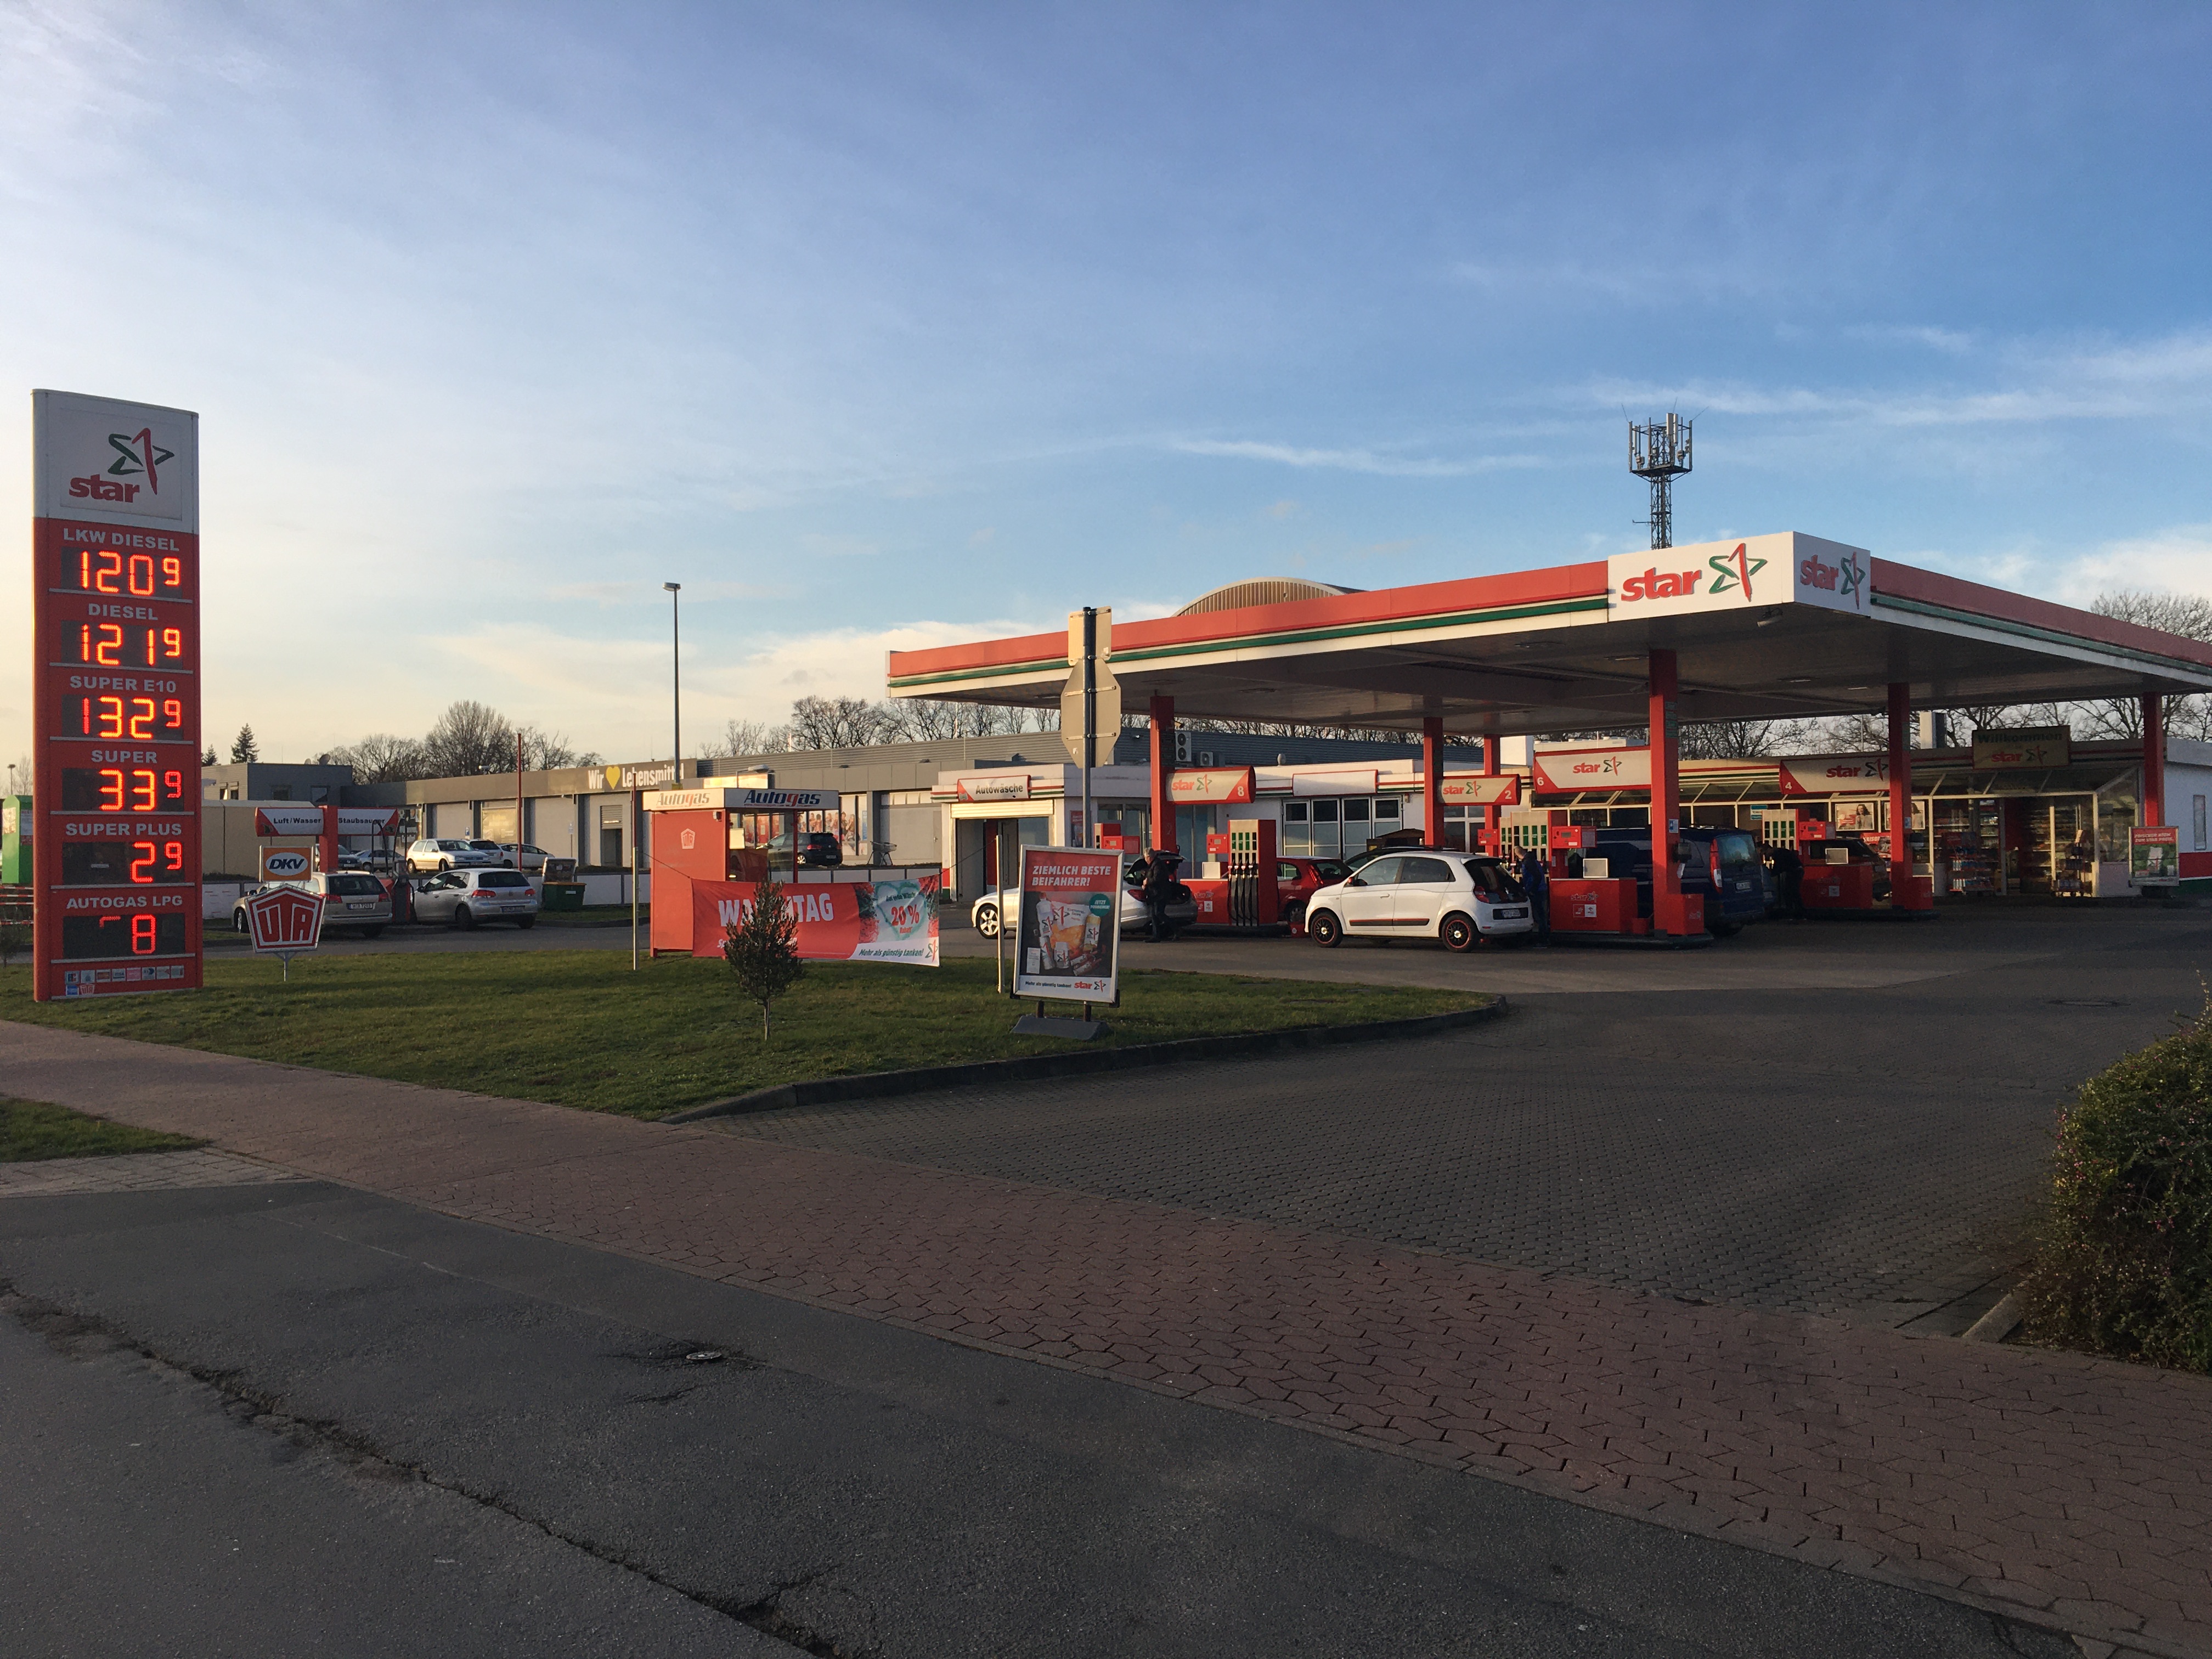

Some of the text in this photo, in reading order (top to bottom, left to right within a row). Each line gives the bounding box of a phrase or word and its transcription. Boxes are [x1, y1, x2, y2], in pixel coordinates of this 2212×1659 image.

[69, 473, 140, 503] star
[63, 528, 179, 552] LKW DIESEL
[1801, 554, 1839, 591] star
[1621, 567, 1702, 602] star
[88, 603, 159, 621] DIESEL
[70, 676, 177, 693] SUPER E10
[91, 750, 157, 764] SUPER
[1991, 751, 2023, 762] star
[1573, 763, 1600, 774] star
[1826, 765, 1861, 778] star
[588, 769, 605, 789] Wir
[1172, 779, 1195, 791] star
[1537, 777, 1544, 786] 6
[975, 783, 1024, 795] Autowäsche
[1238, 786, 1244, 797] 8
[1443, 785, 1465, 795] star
[1505, 790, 1512, 799] 2
[656, 792, 710, 807] Autogas
[744, 790, 821, 807] Autogas
[65, 823, 182, 836] SUPER PLUS
[269, 859, 304, 869] DKV
[1032, 866, 1111, 876] ZIEMLICH BESTE
[1032, 877, 1090, 887] BEIFAHRER!
[66, 895, 183, 910] AUTOGAS LPG
[718, 893, 834, 927] WAHTAG
[882, 949, 903, 957] günstig
[903, 949, 924, 957] tanken!
[1074, 981, 1093, 990] star
